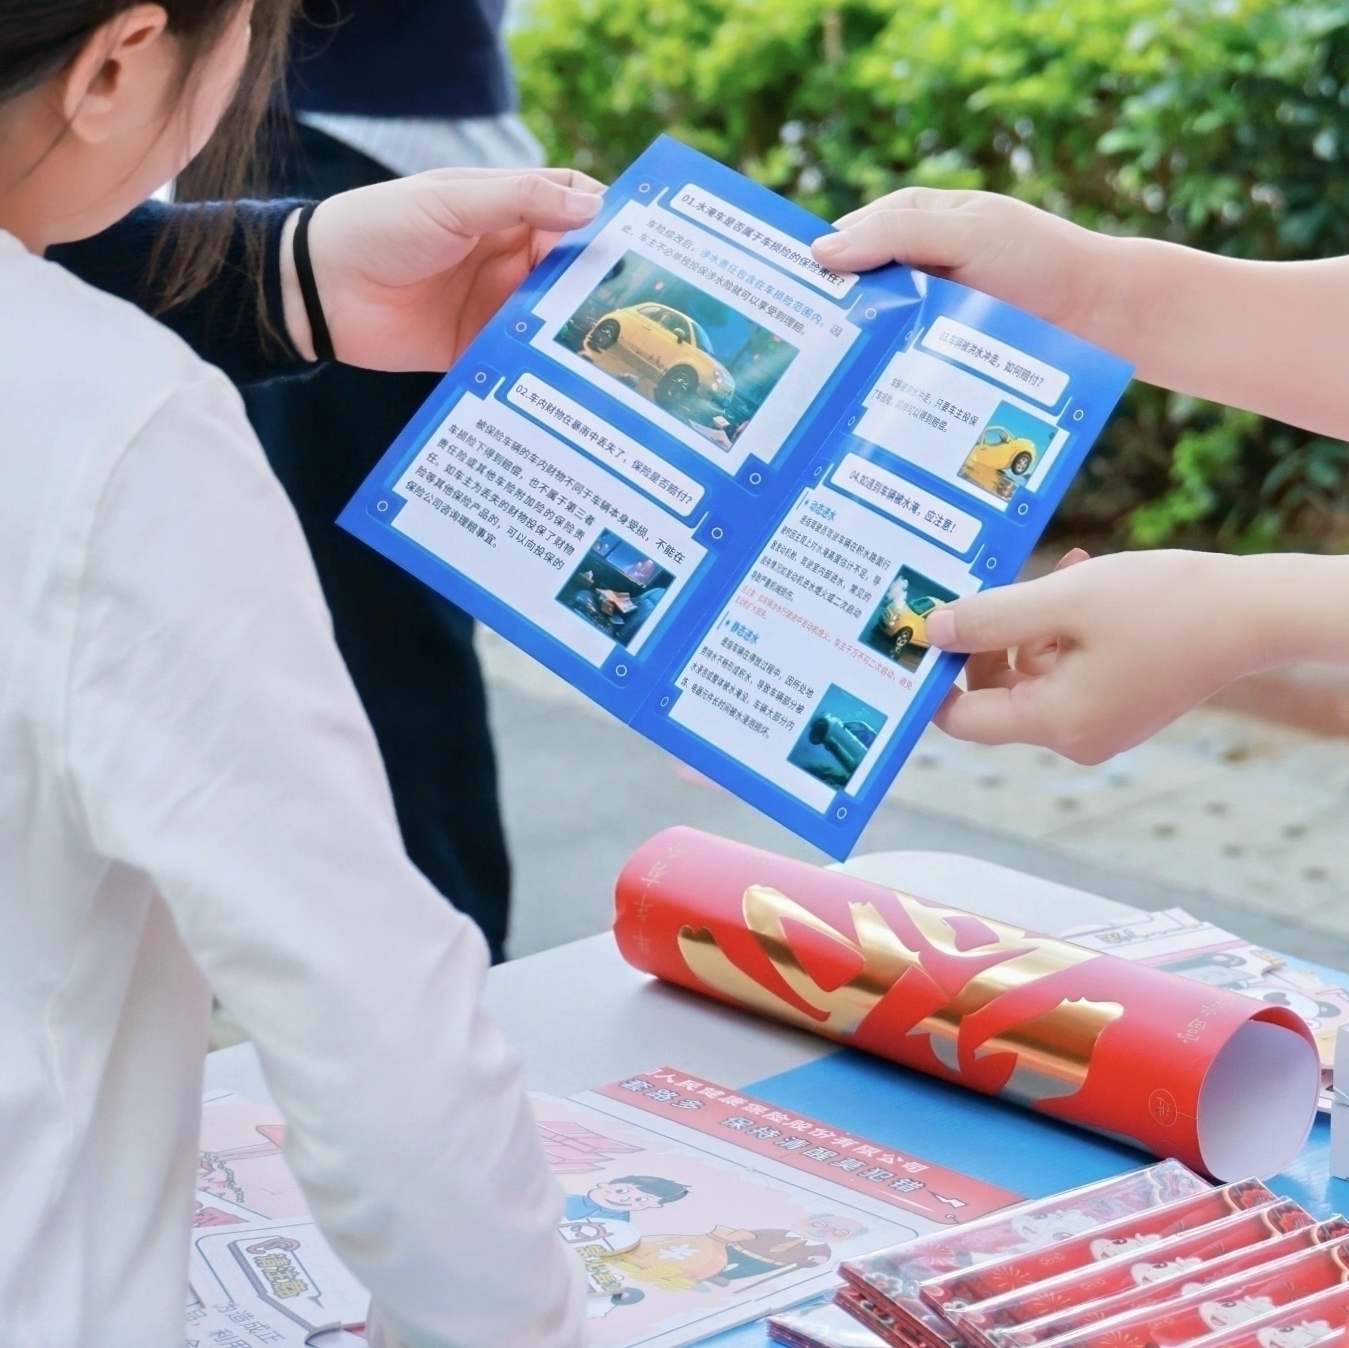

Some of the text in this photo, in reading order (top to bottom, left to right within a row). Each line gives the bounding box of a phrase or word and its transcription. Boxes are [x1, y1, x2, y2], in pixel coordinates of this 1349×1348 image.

[434, 437, 586, 542] 责任险或其他车险附加险的保险责
[445, 423, 596, 527] 车损险下得到赔偿，也不属于第三者
[473, 418, 687, 565] 被保险车辆的车内财物不同于车辆本身受损，不能在
[513, 383, 694, 506] 02.车内财物在暴雨中丢失了，保险是否赔付？
[403, 479, 503, 550] 保险公司咨询理赔事宜。
[413, 465, 566, 571] 险等其他保险产品的，可以向投保的
[424, 450, 576, 556] 任。如车主为丢失的财物投保了财物
[808, 499, 838, 521] 动态进水
[719, 635, 815, 699] 是指车辆在停放过程中，因所处地
[729, 620, 761, 646] 静态进水
[618, 1078, 927, 1195] 套路多 保持清醒莫犯错
